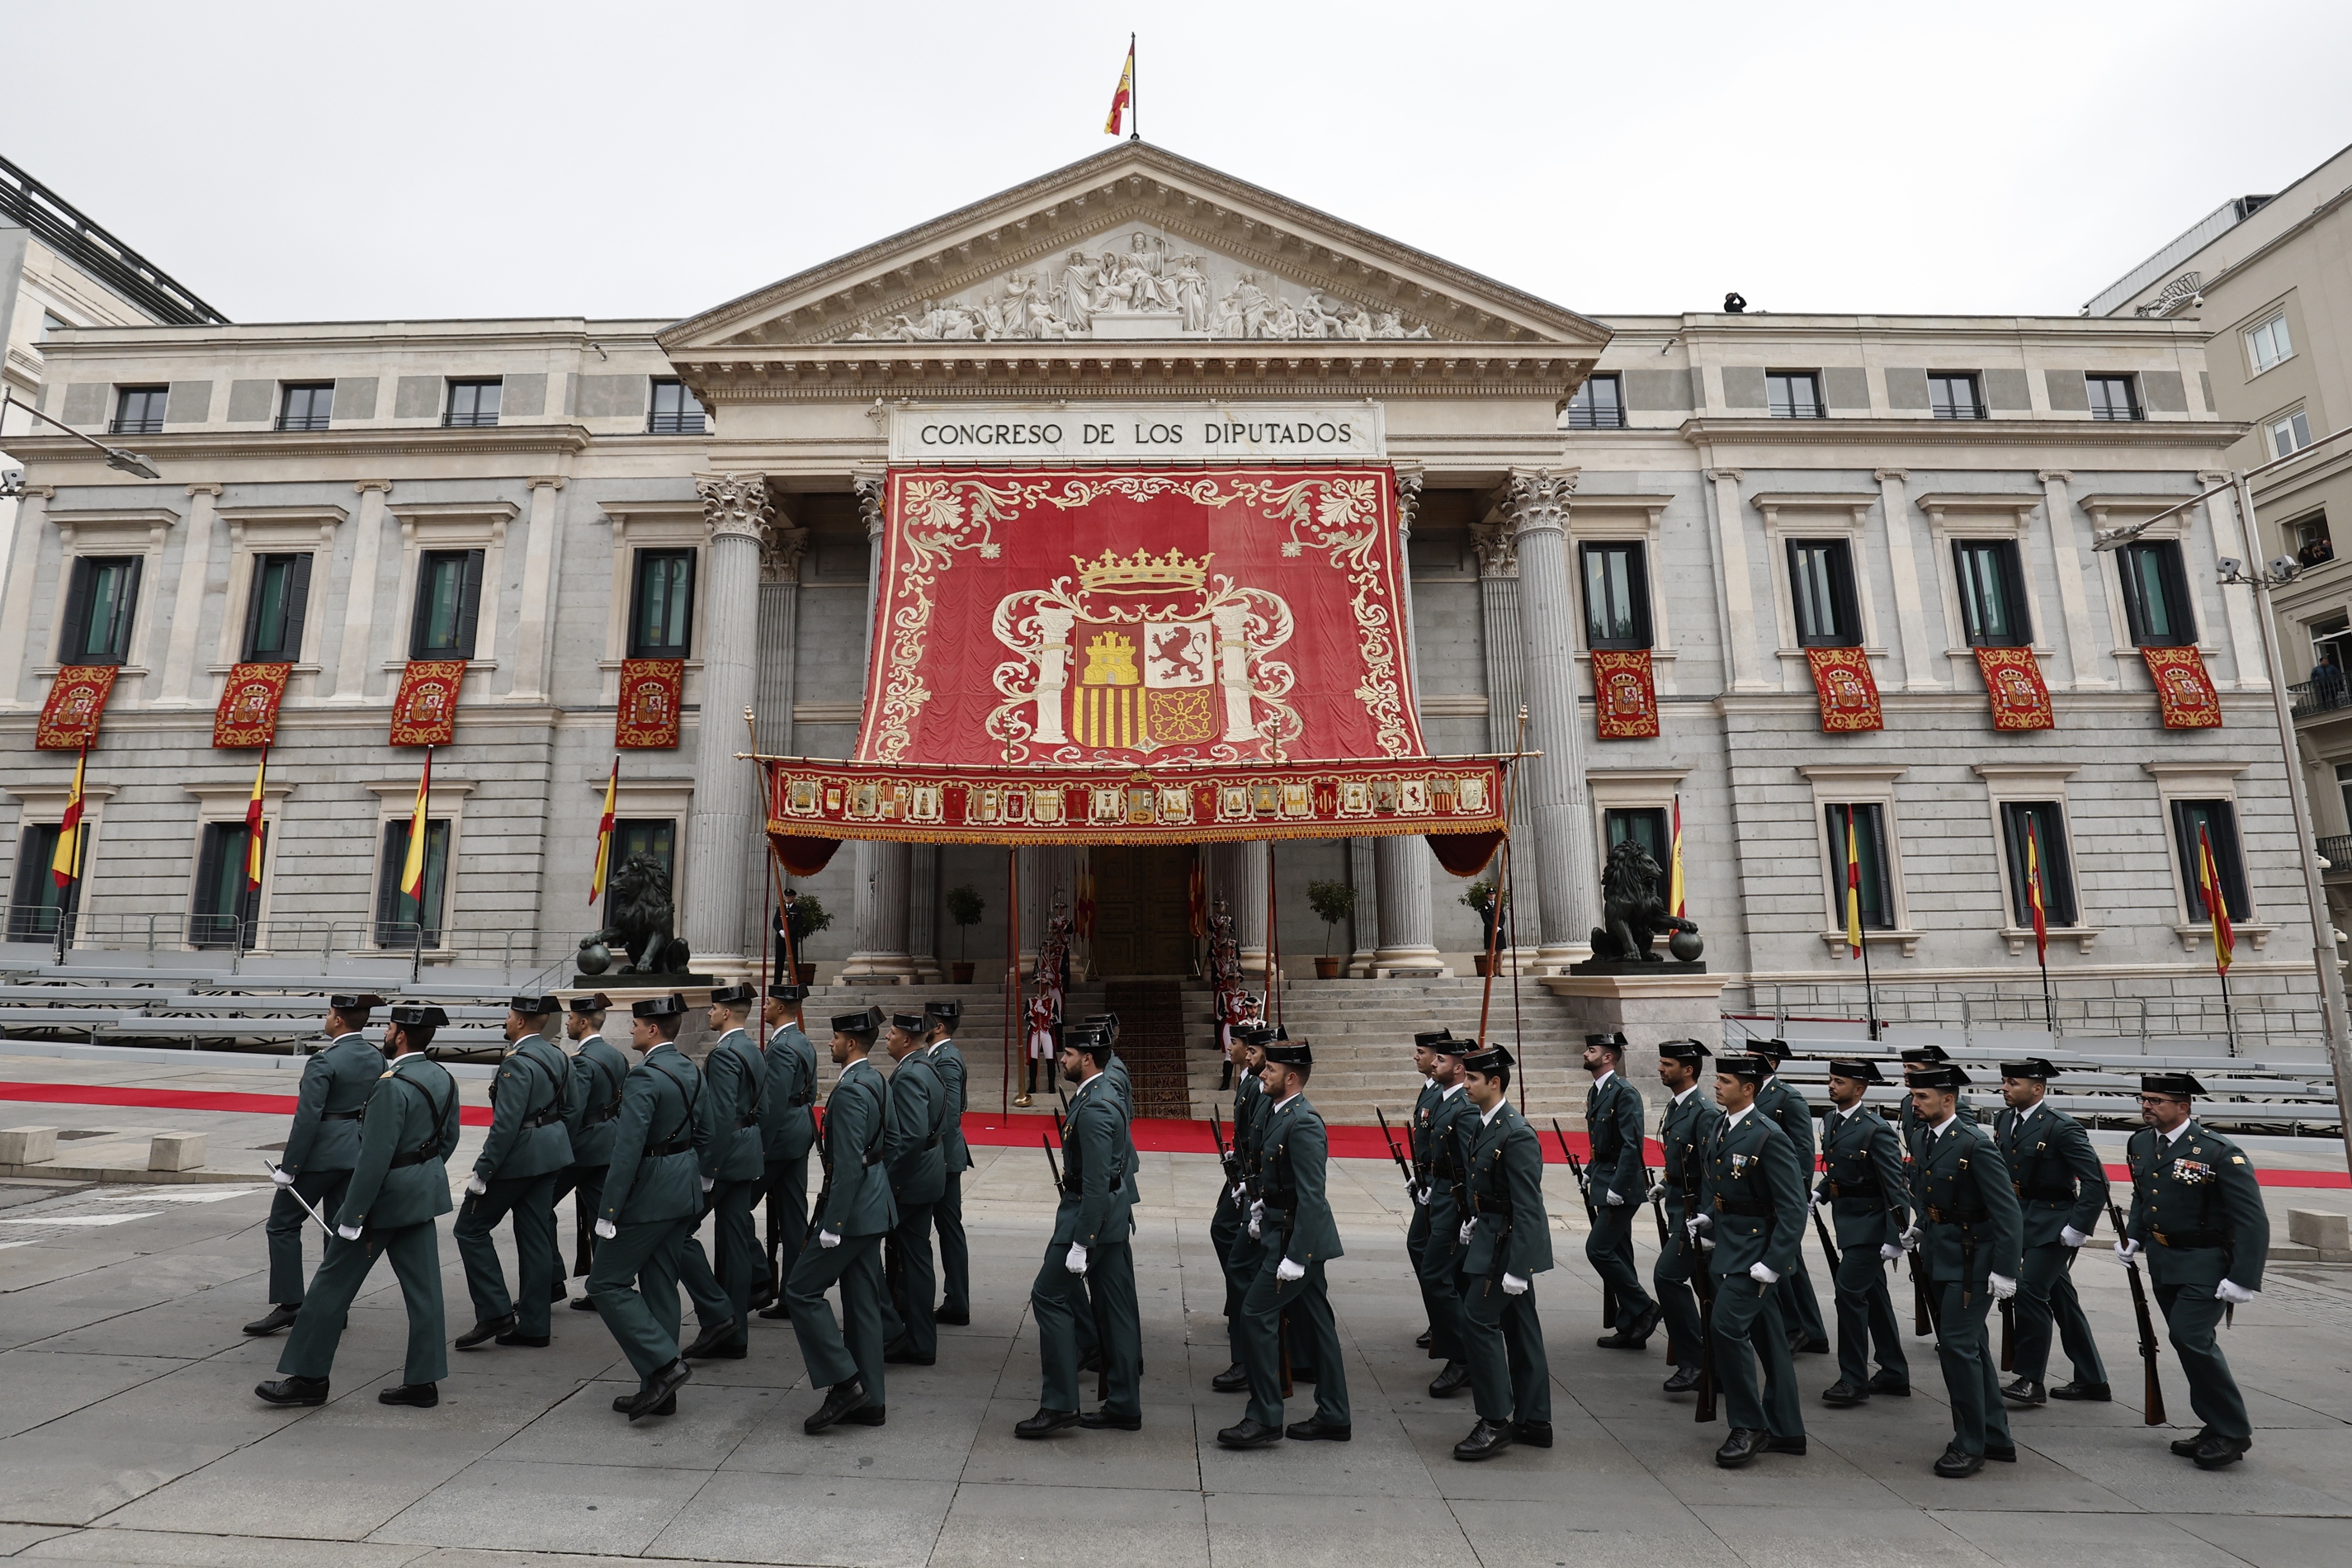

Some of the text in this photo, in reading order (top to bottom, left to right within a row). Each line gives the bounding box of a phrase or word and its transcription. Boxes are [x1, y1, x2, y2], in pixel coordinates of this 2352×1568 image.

[921, 423, 1352, 445] CONGRESO DE LOS DIPUTADOS
